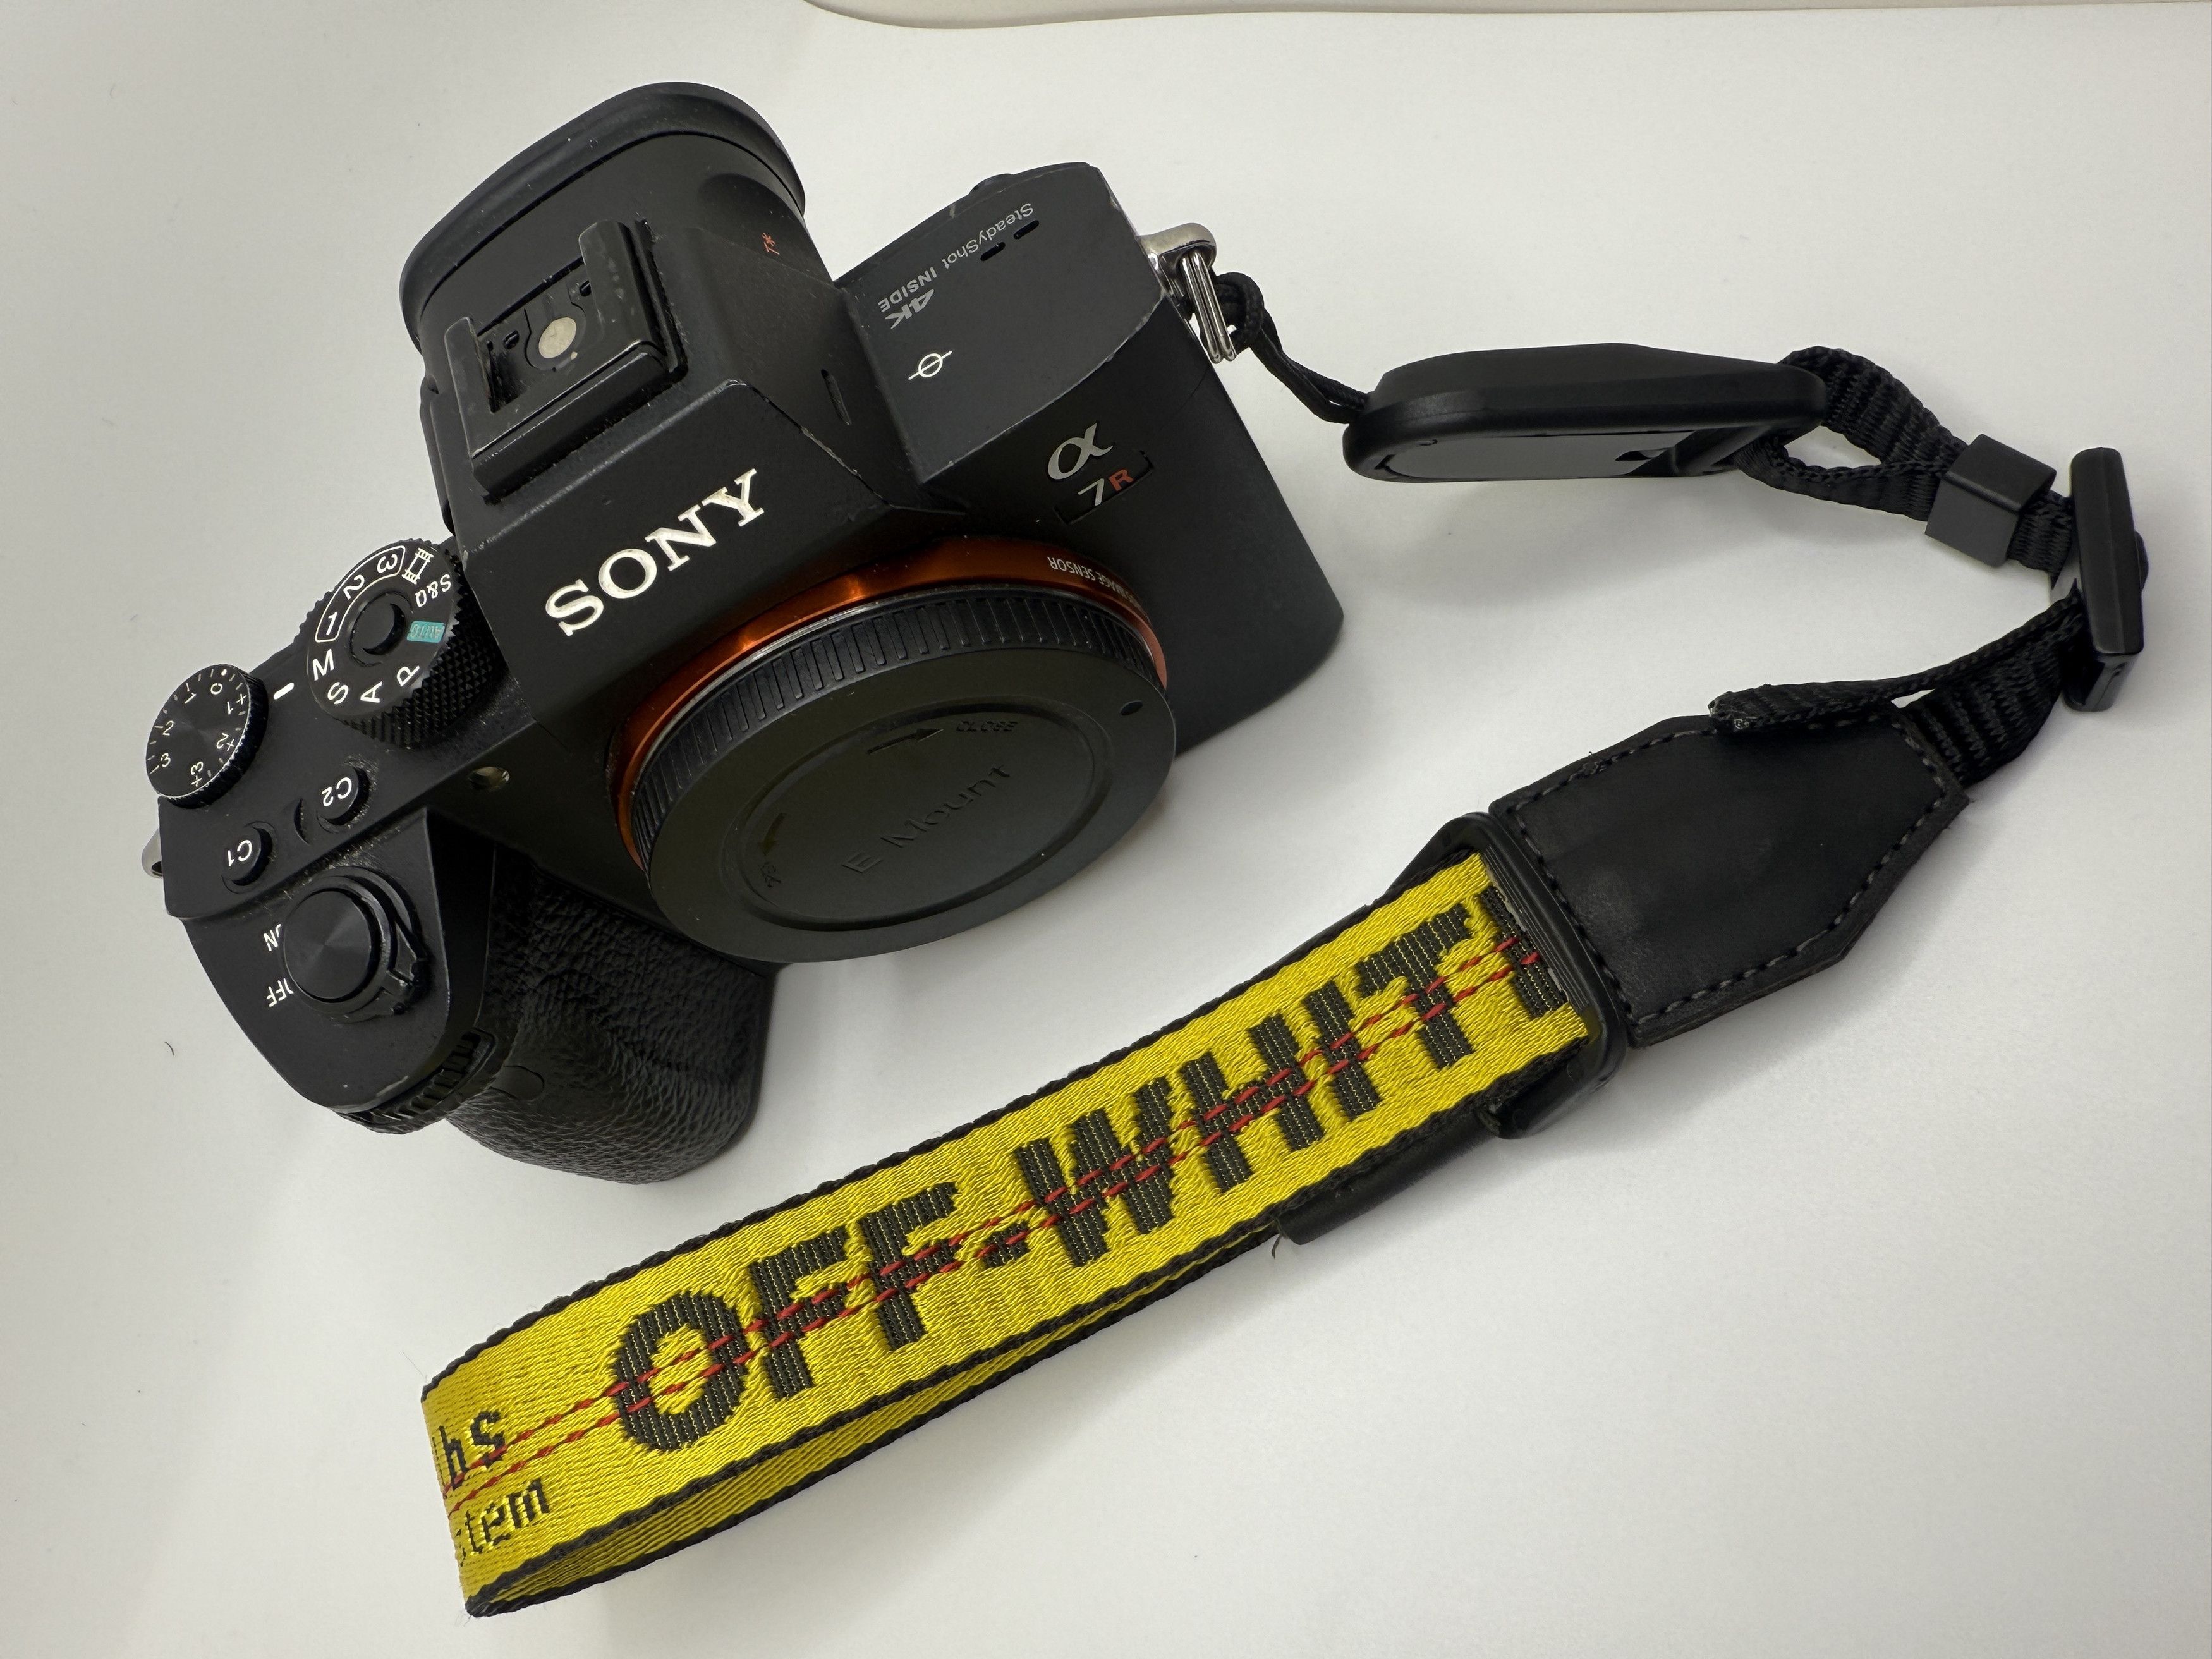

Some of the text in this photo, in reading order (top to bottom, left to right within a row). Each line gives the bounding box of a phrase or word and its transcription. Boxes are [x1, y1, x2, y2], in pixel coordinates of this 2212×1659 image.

[878, 202, 1034, 313] SteadyShot INSIDE
[884, 289, 935, 329] 4K
[1078, 468, 1134, 506] 7R
[545, 468, 765, 636] SONY
[1047, 556, 1097, 581] SENSOR
[326, 554, 398, 635] 1 2 3
[312, 648, 334, 681] M
[397, 665, 420, 687] P
[327, 682, 348, 705] S
[360, 681, 382, 703] A
[322, 777, 353, 807] C2
[227, 839, 253, 866] C1
